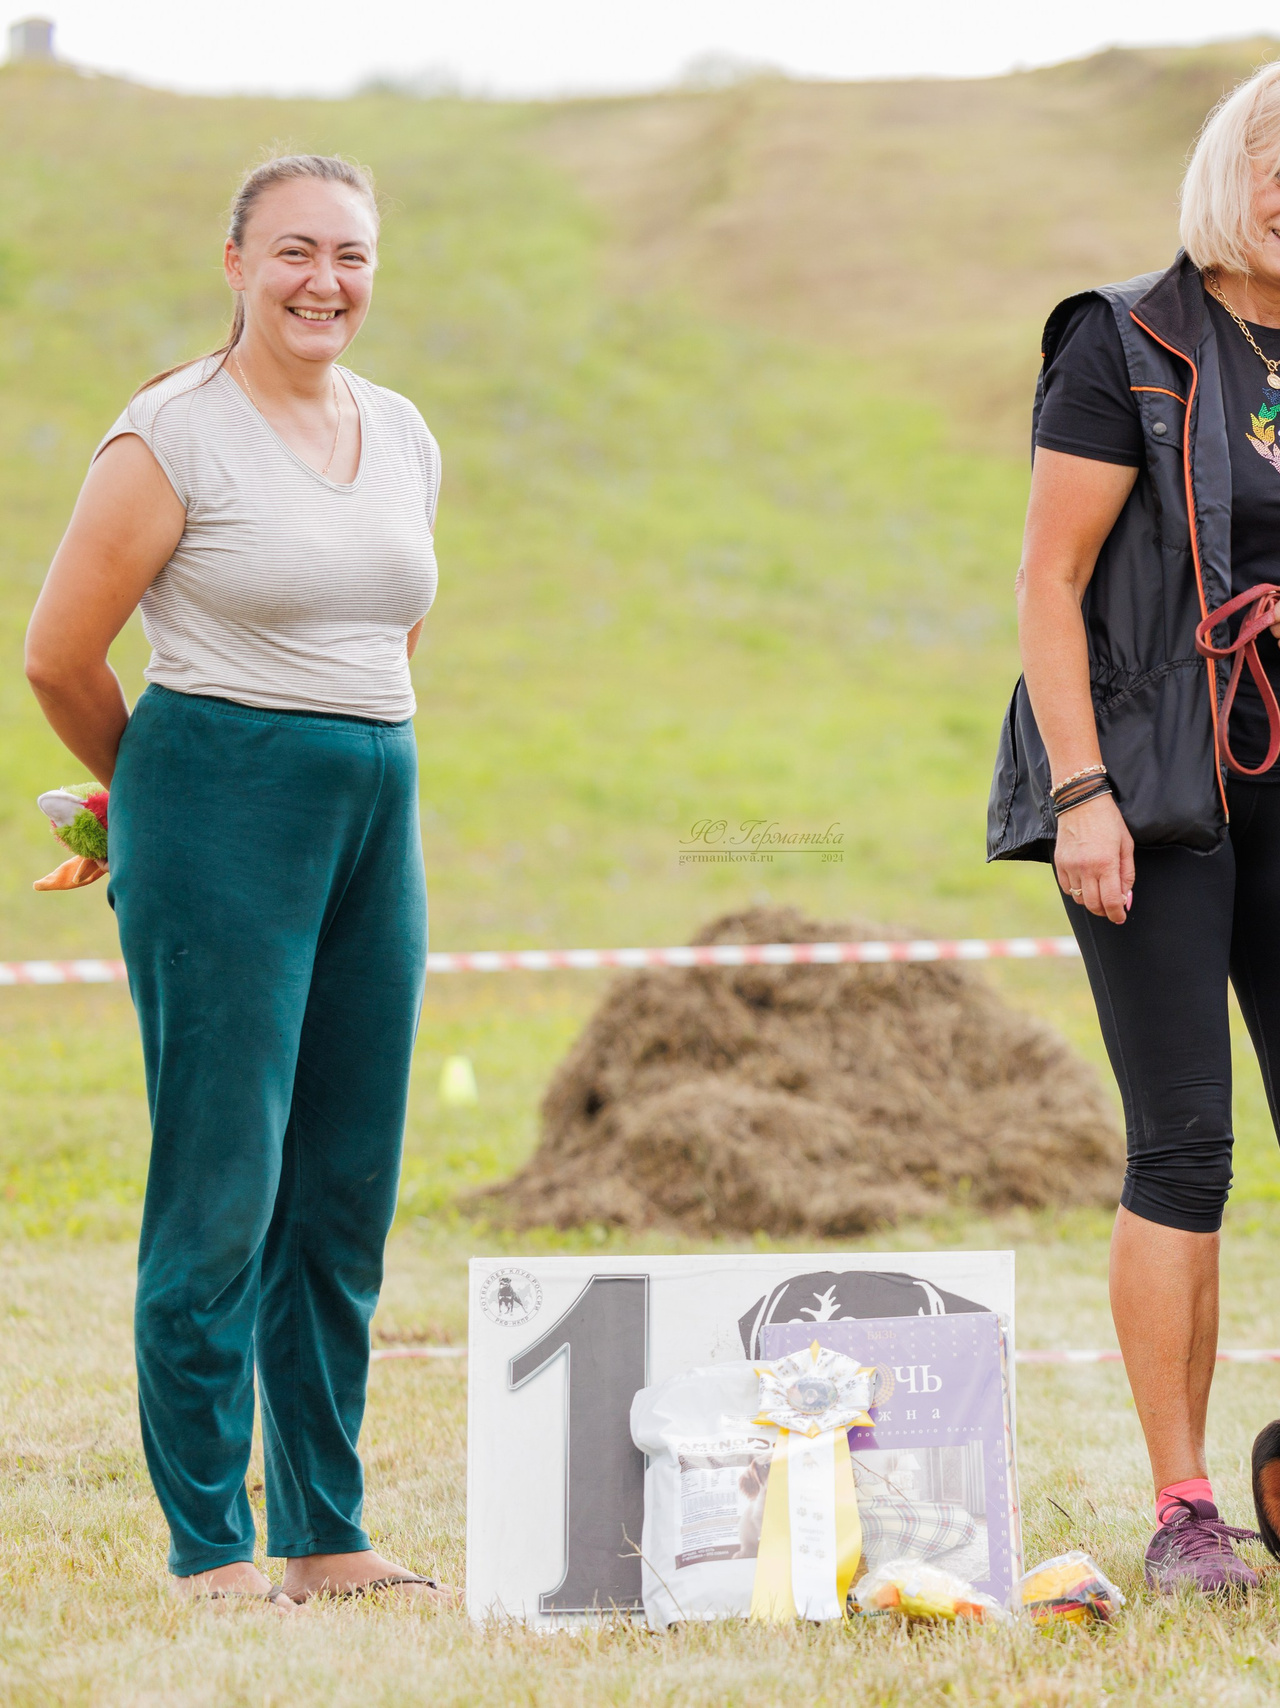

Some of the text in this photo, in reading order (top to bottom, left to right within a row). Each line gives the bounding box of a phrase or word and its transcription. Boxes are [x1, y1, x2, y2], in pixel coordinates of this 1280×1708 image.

[867, 1329, 897, 1340] БЯЗЬ
[857, 1427, 938, 1438] постельного
[509, 1273, 650, 1613] 1
